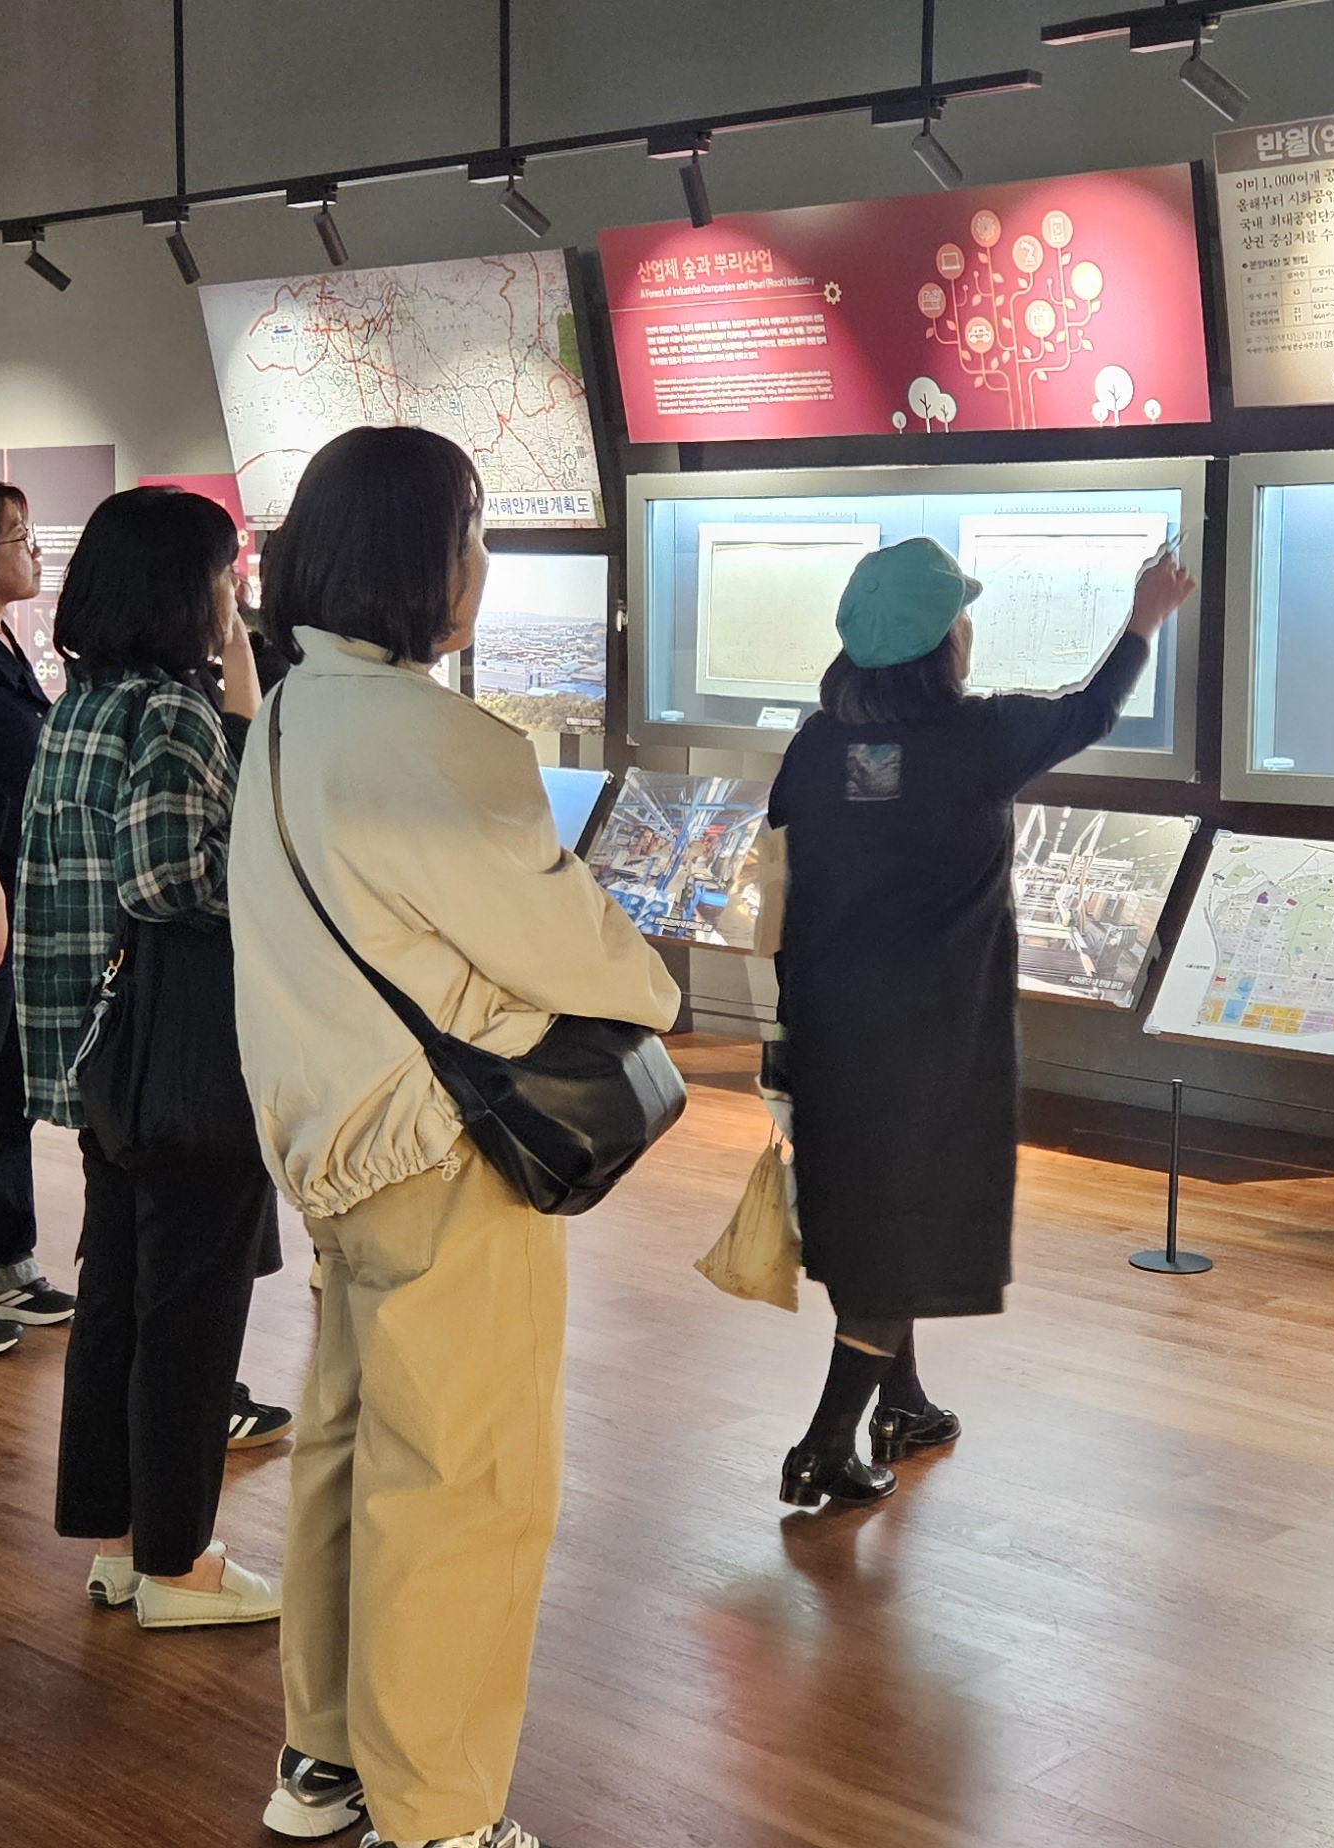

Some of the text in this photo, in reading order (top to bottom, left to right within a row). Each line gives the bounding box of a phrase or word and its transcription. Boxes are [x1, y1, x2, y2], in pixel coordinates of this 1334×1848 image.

[1235, 178, 1258, 193] 이미
[1262, 170, 1321, 189] 1,000여개
[1236, 193, 1284, 213] 올해부터
[1239, 216, 1263, 231] 국내
[1241, 236, 1265, 250] 상권
[1268, 229, 1318, 248] 중심지를
[637, 248, 774, 284] 산업체 숲과 뿌리산업
[672, 284, 701, 297] Industrial
[701, 282, 736, 296] Companies
[787, 275, 815, 288] Industry
[487, 495, 591, 516] 서해안개발계획도
